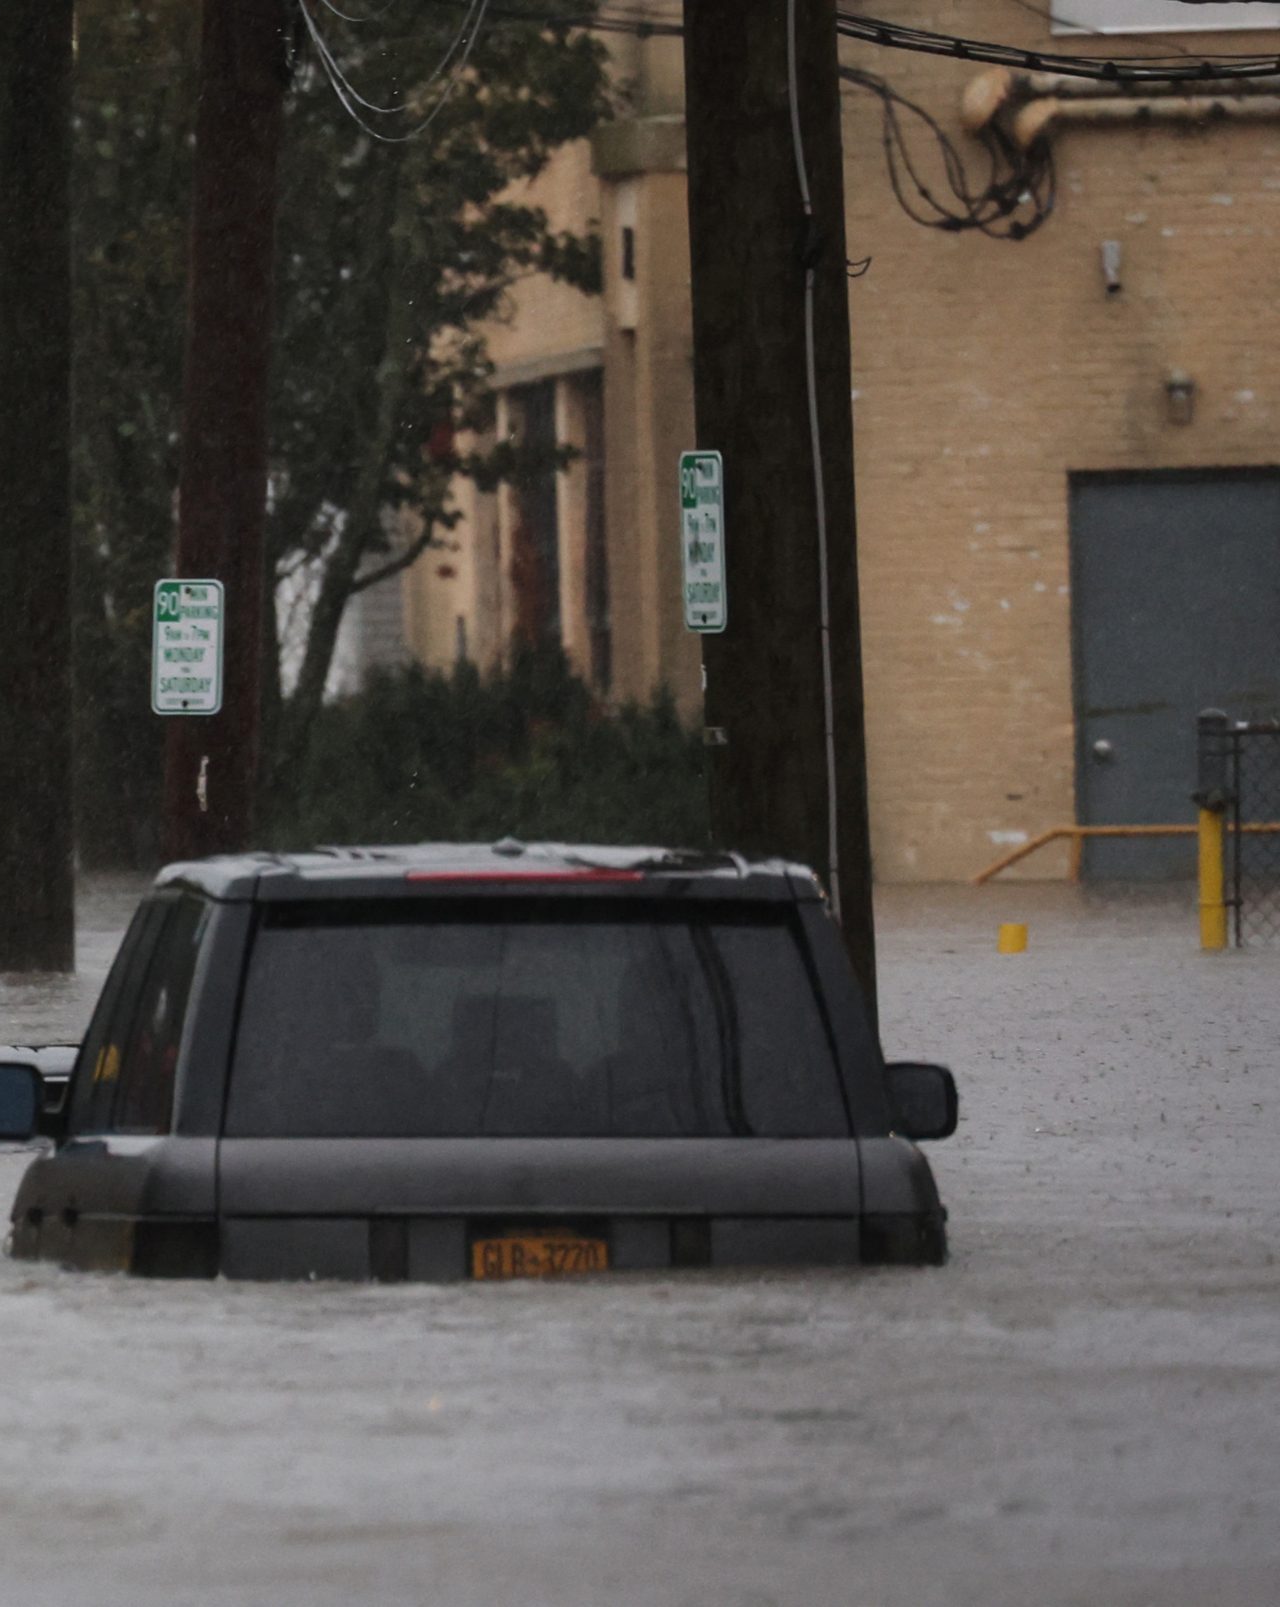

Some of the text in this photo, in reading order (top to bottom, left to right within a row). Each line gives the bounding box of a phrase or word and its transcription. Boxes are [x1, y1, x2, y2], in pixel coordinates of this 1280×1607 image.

[683, 468, 696, 499] 90
[158, 591, 179, 615] 90
[180, 605, 218, 619] PARKING
[164, 647, 206, 662] MONDAY
[160, 676, 213, 693] SATURDAY
